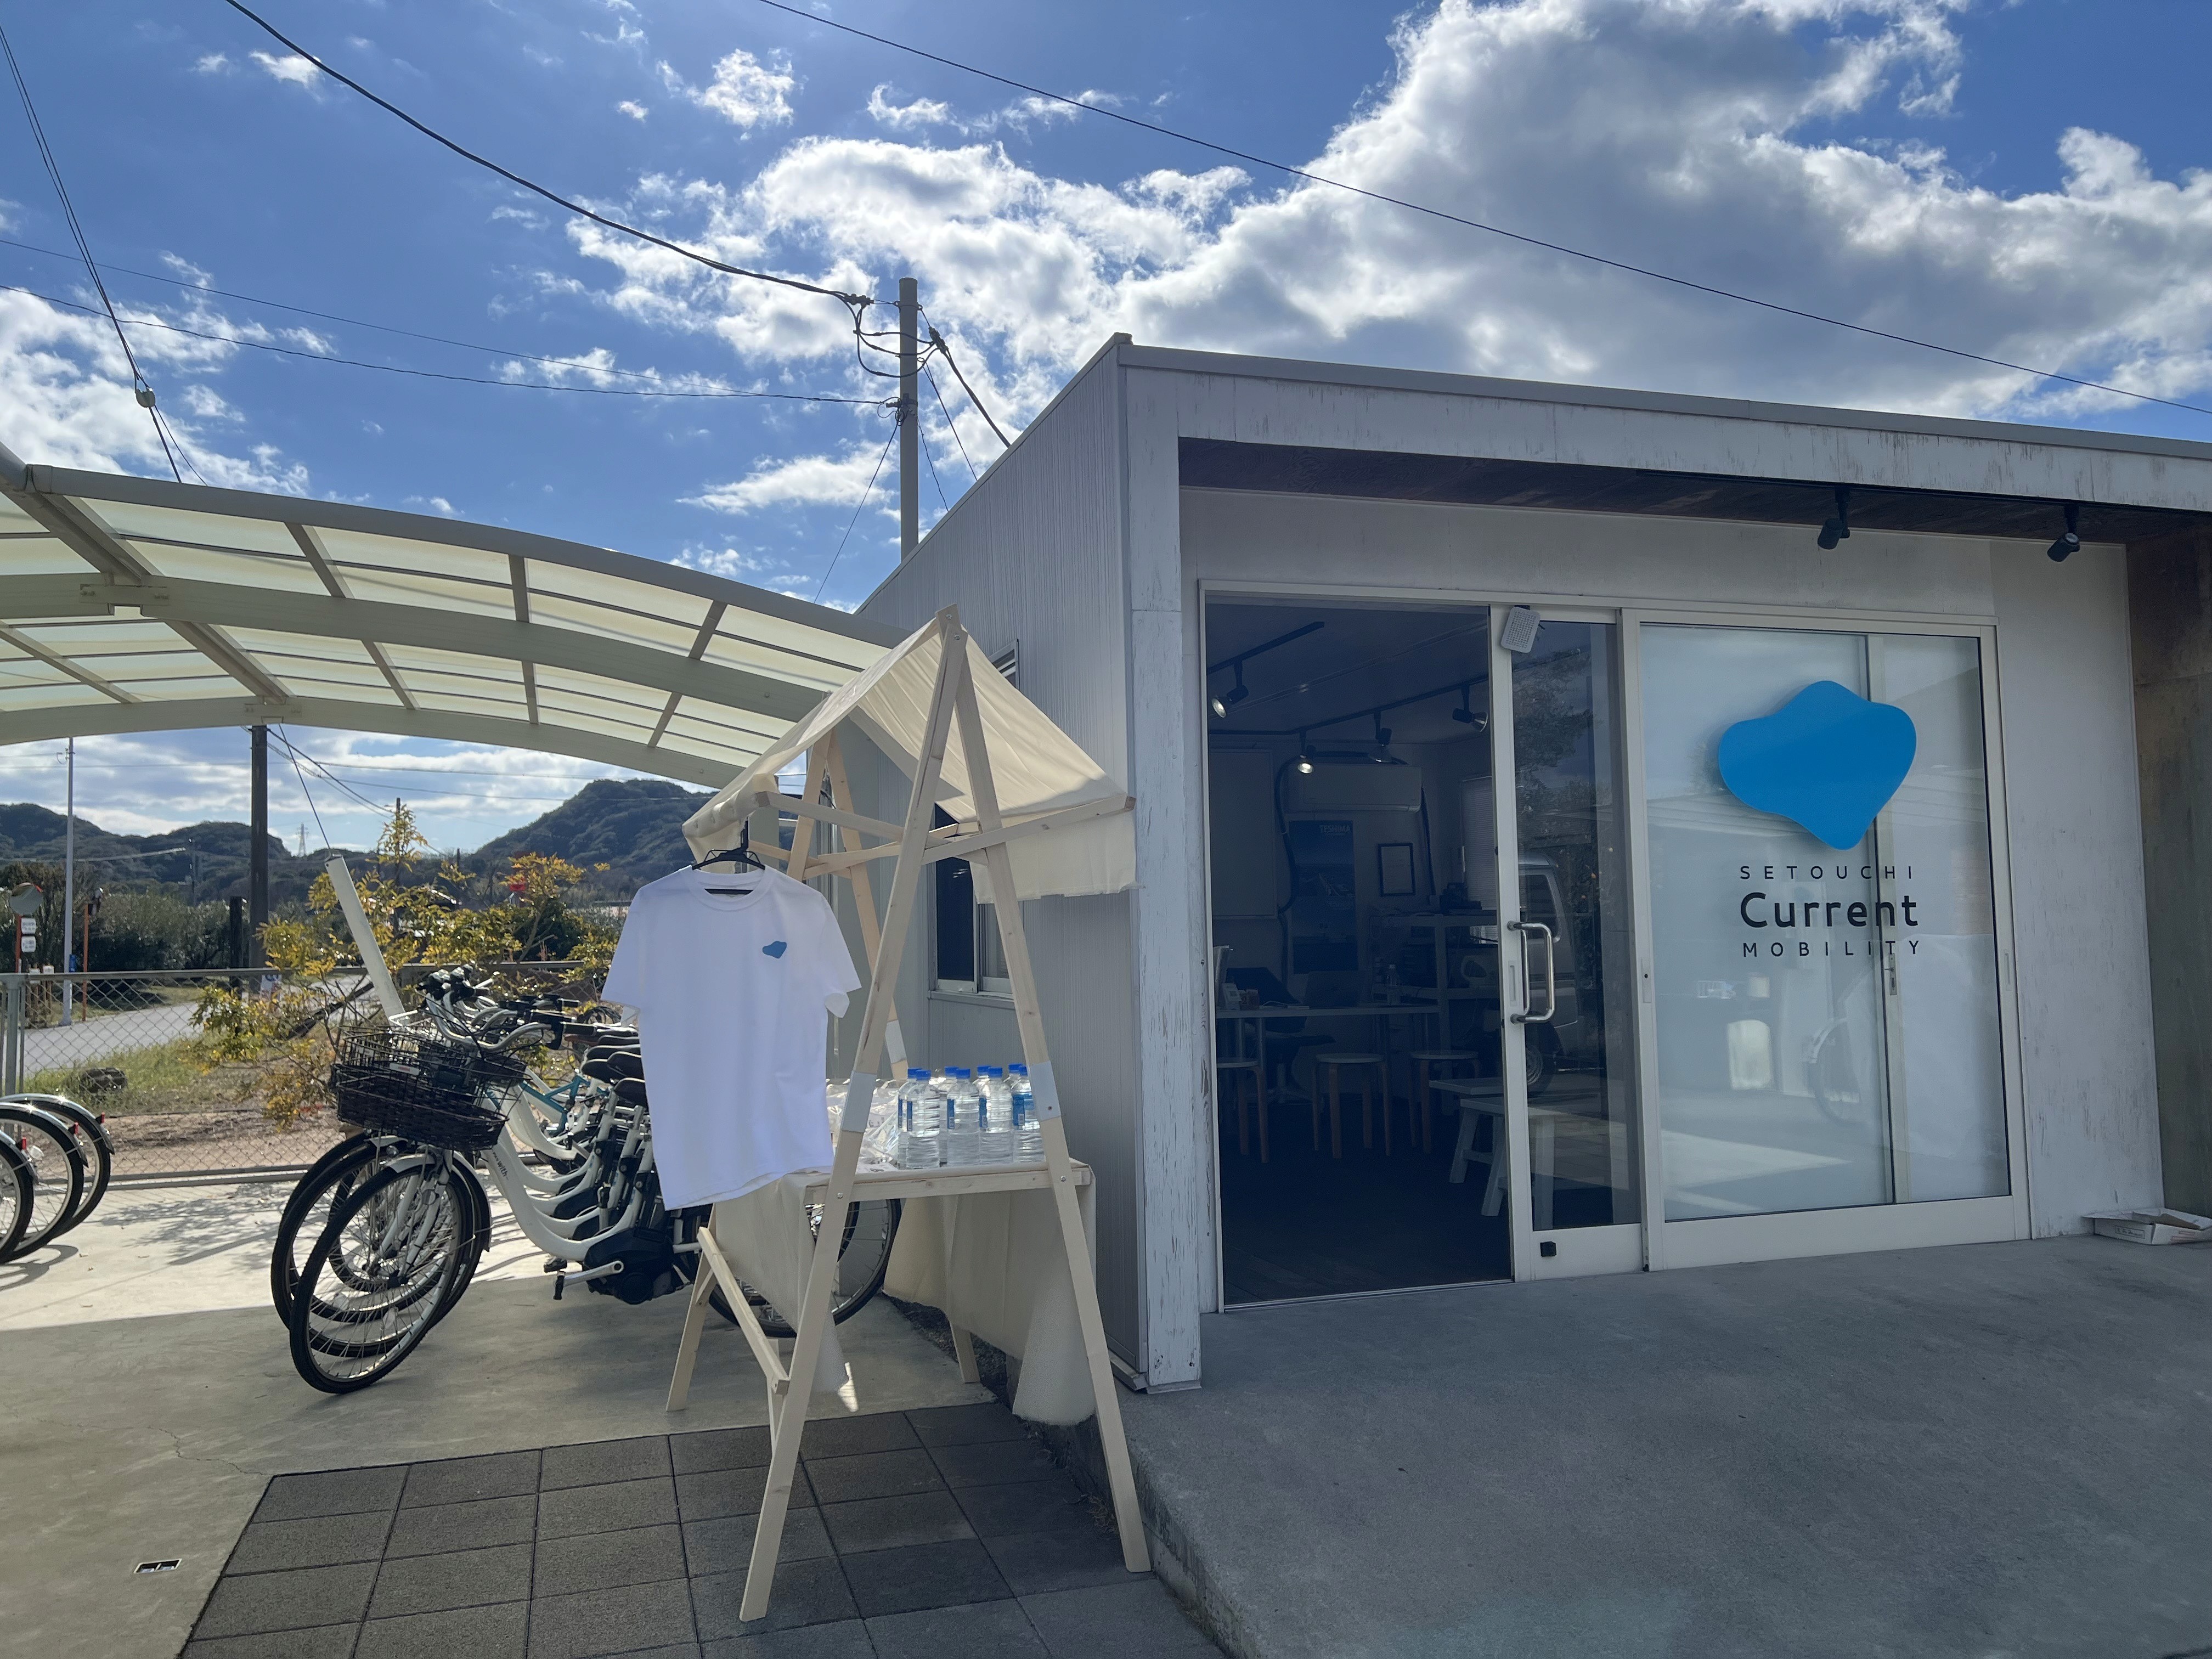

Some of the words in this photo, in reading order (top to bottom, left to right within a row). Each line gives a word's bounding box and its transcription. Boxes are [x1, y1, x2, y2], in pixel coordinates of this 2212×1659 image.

[1319, 825, 1351, 833] TESHIMA
[1740, 866, 1912, 879] SETOUCHI
[1740, 891, 1919, 928] Current
[1743, 940, 1919, 957] MOBILITY
[497, 1161, 507, 1177] with
